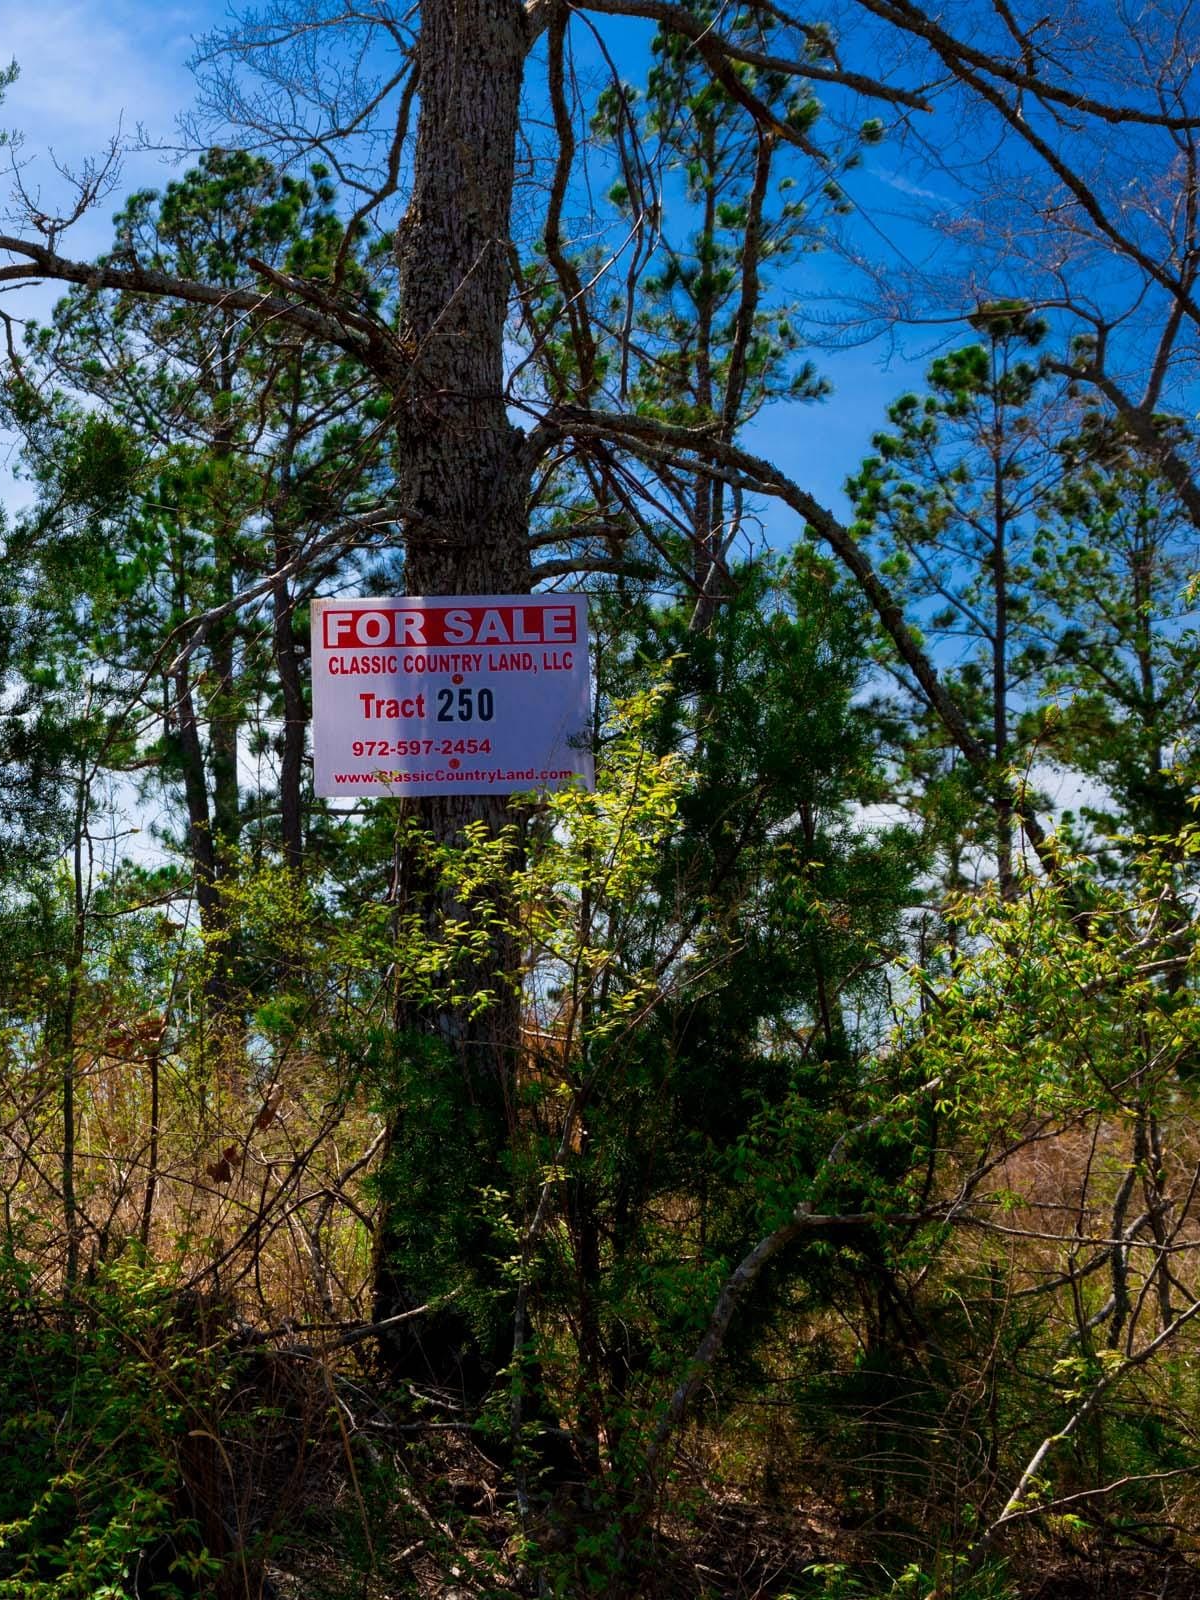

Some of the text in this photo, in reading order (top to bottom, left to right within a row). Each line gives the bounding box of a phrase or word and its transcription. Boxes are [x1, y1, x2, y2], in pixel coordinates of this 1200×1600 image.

[327, 608, 573, 646] FOR SALE
[328, 651, 573, 675] CLASSIC COUNTRY LAND, LLC
[359, 688, 494, 722] Tract 250
[352, 739, 491, 757] 972-597-2454
